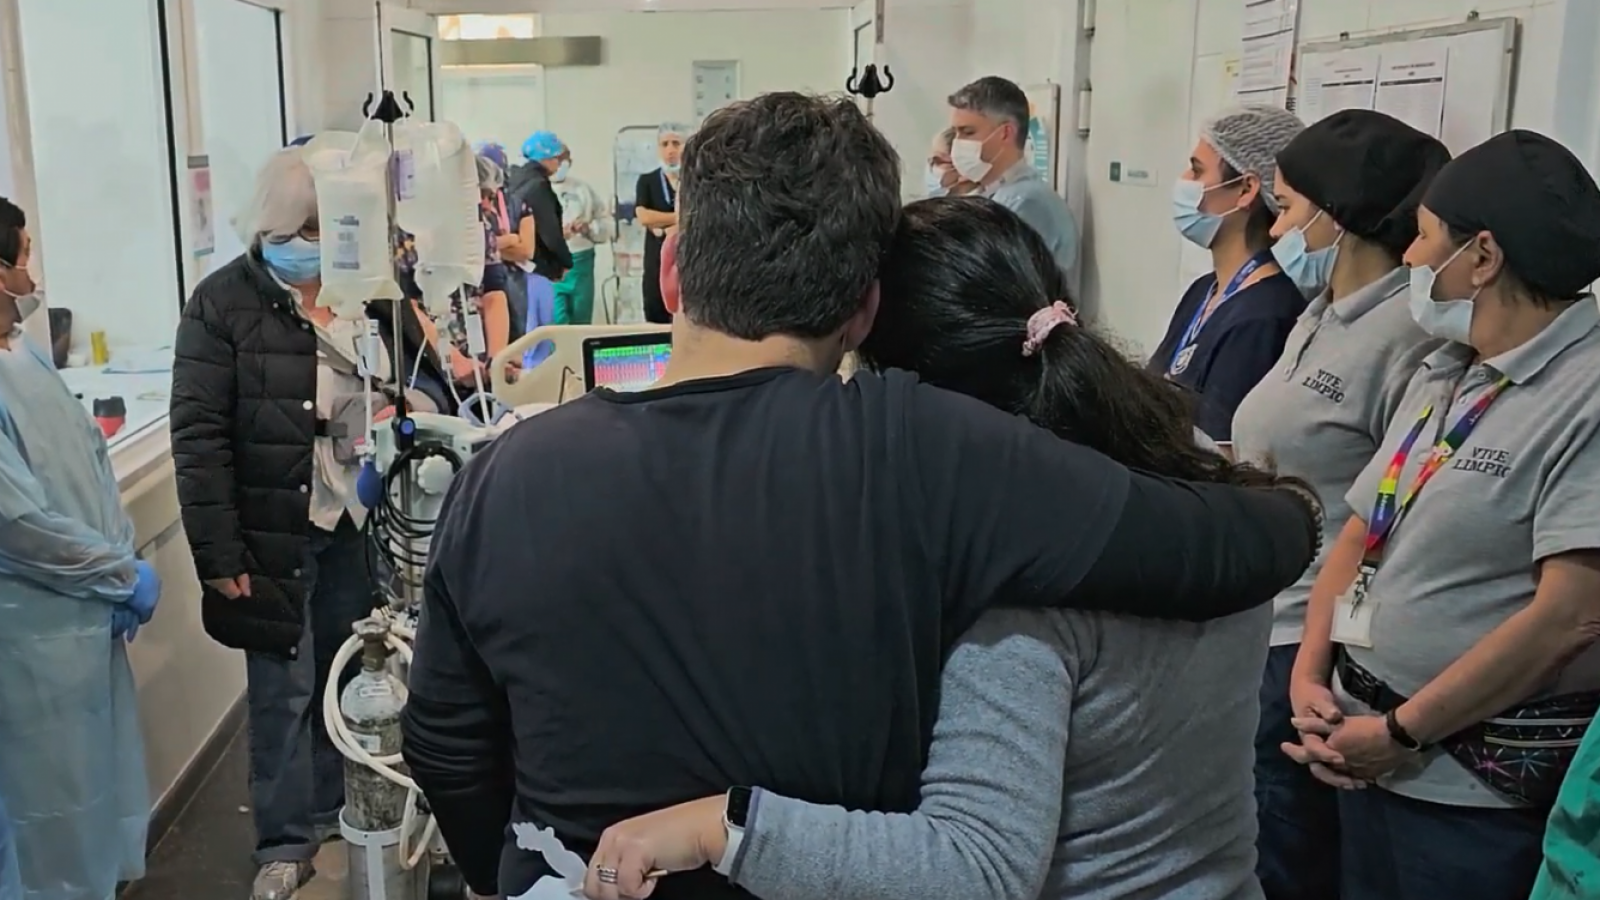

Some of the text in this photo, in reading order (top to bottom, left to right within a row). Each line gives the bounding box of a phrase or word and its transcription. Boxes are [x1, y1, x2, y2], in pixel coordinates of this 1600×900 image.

[1302, 376, 1345, 403] LIMPIO
[1317, 369, 1342, 390] VIVE
[1473, 446, 1509, 463] VIVE
